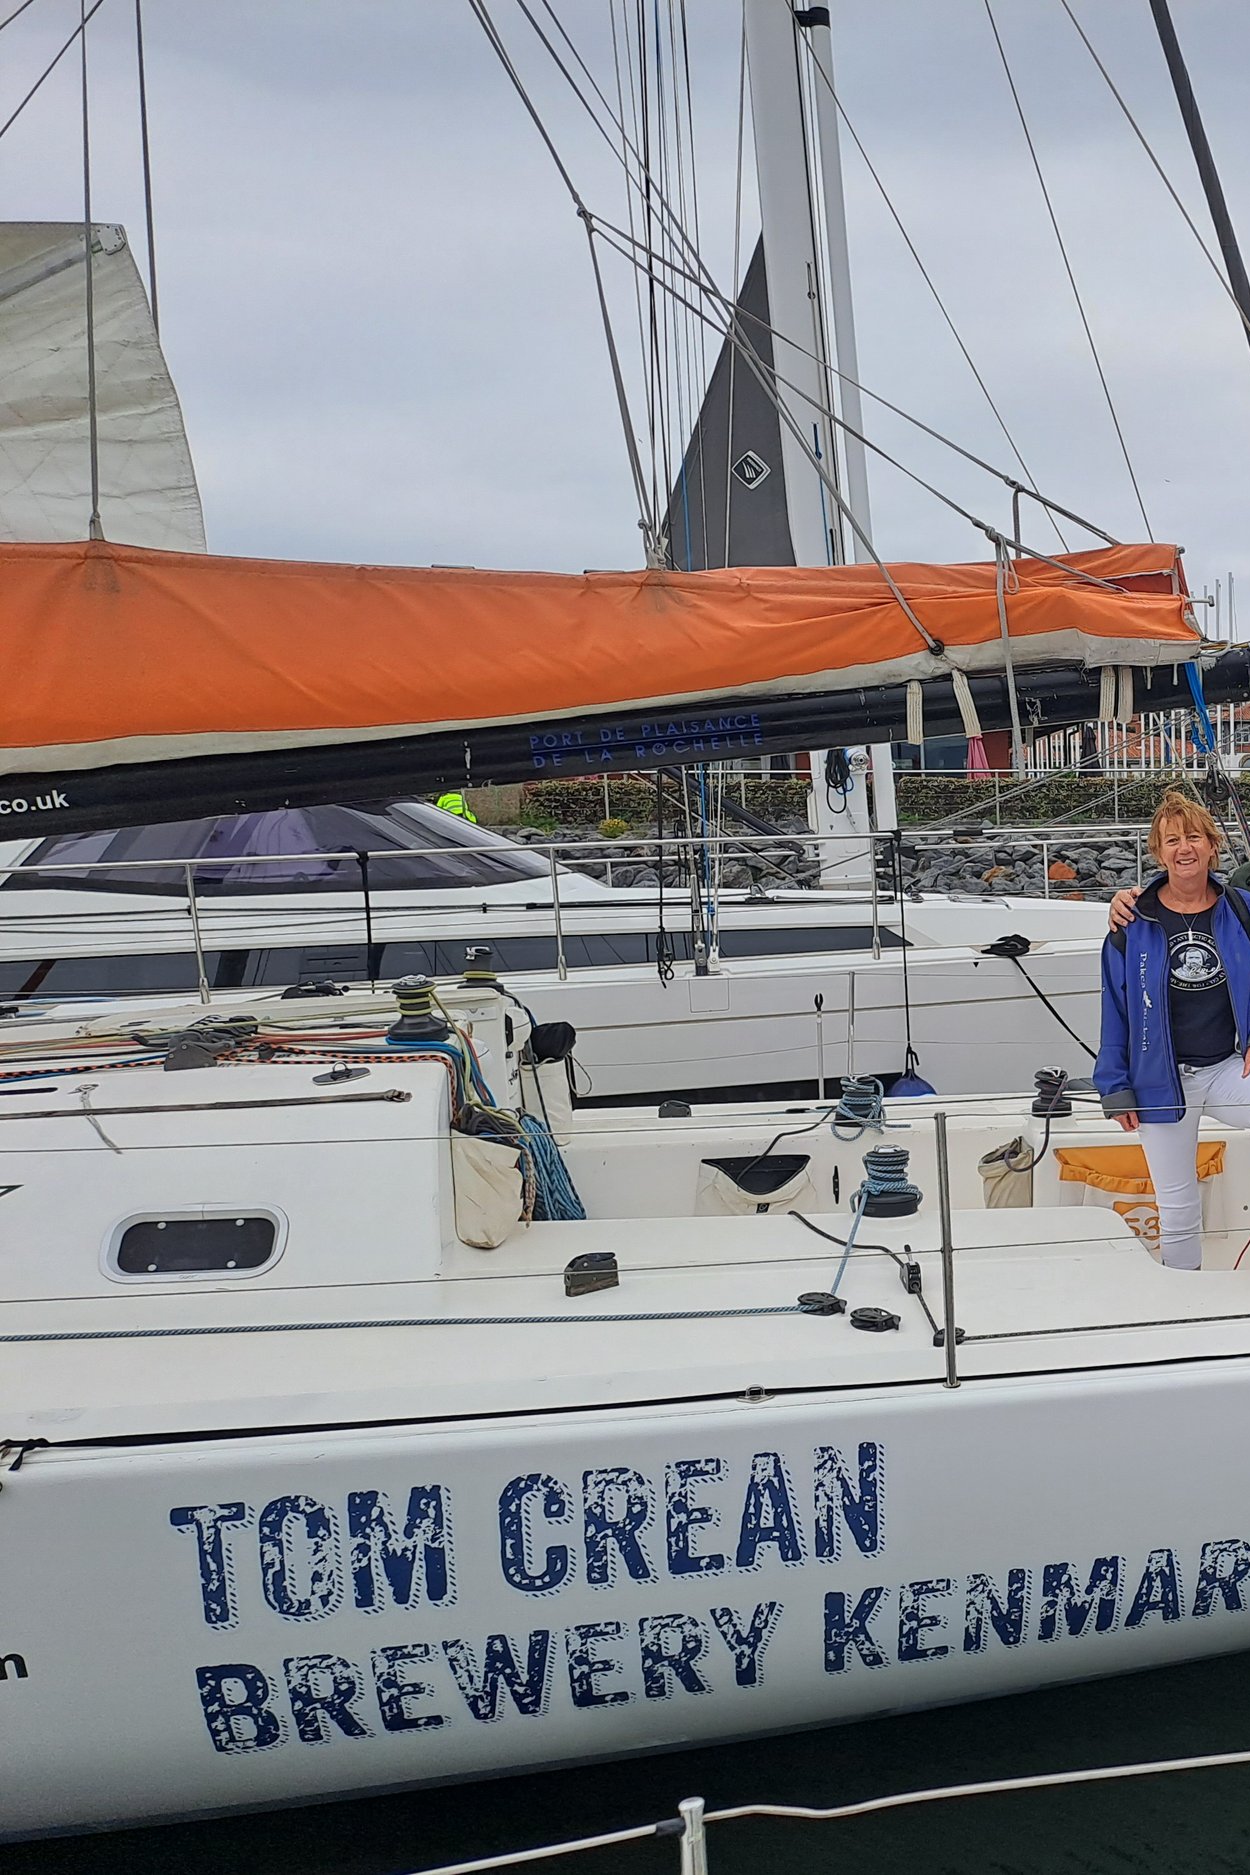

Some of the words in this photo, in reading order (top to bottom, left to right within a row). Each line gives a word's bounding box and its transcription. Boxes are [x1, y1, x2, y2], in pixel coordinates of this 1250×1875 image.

[529, 731, 583, 750] PORT
[600, 726, 625, 743] DE
[641, 713, 761, 738] PLAISANCE
[533, 752, 563, 769] DE
[585, 747, 614, 764] LA
[635, 733, 764, 758] ROCHELLE
[169, 1484, 456, 1631] TOM
[498, 1441, 887, 1600] CREAN
[195, 1601, 783, 1755] BREWERY
